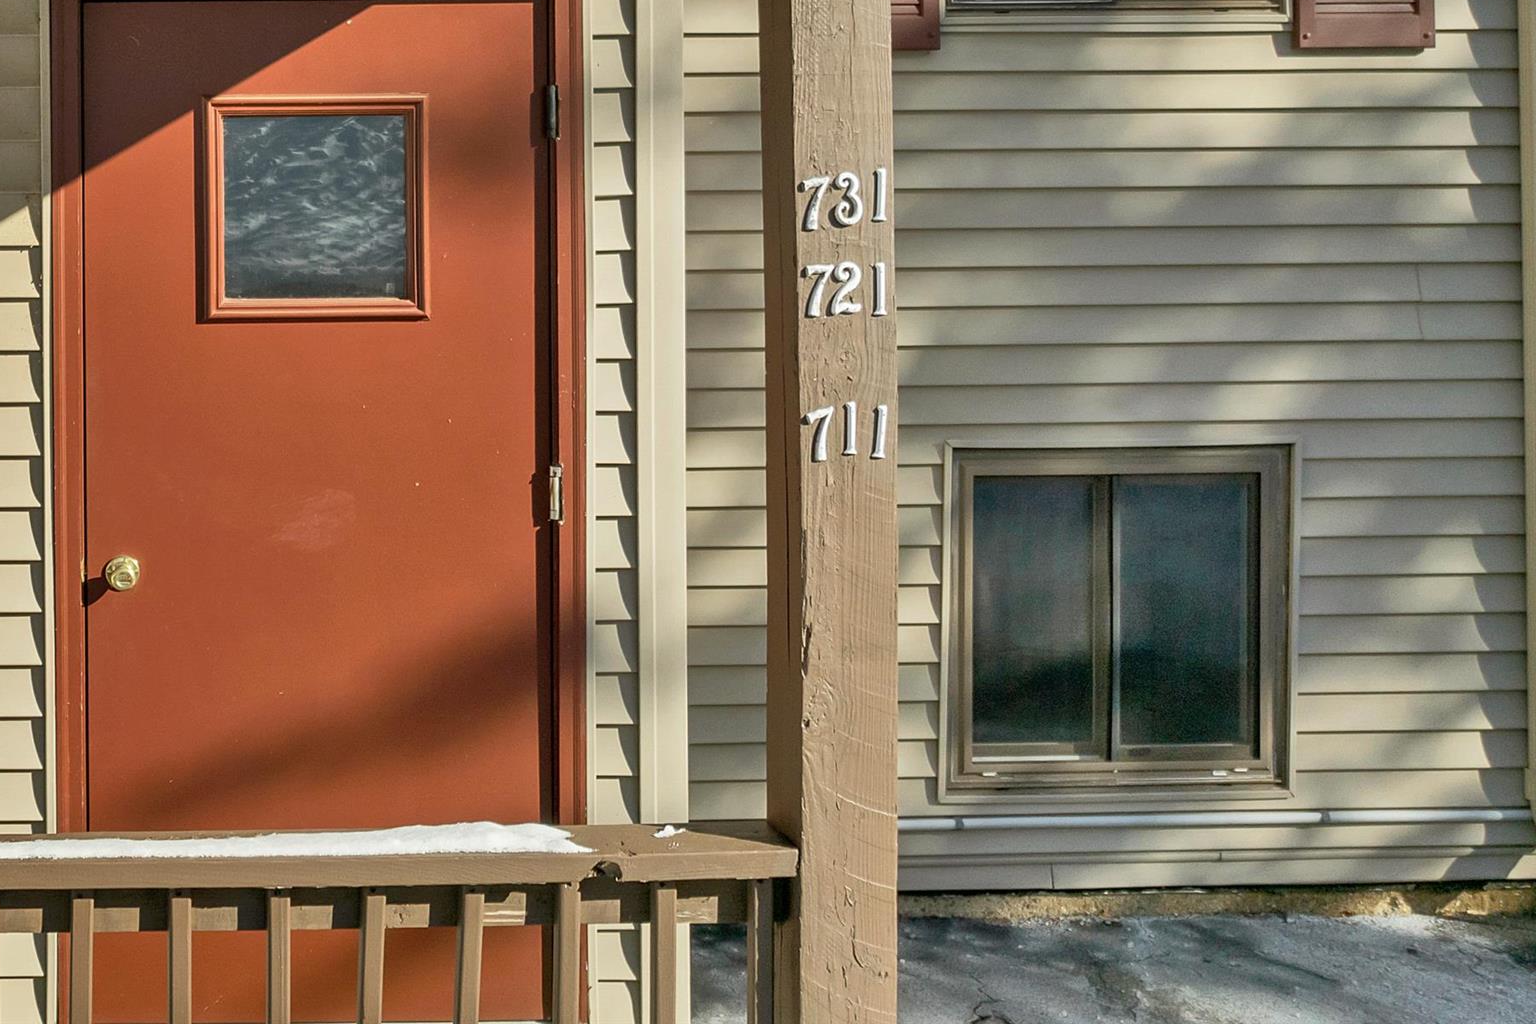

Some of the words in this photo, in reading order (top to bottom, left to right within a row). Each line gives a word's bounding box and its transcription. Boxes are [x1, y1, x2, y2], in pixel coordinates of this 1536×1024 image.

[798, 168, 887, 230] 731
[802, 261, 888, 317] 721
[801, 400, 888, 463] 711
